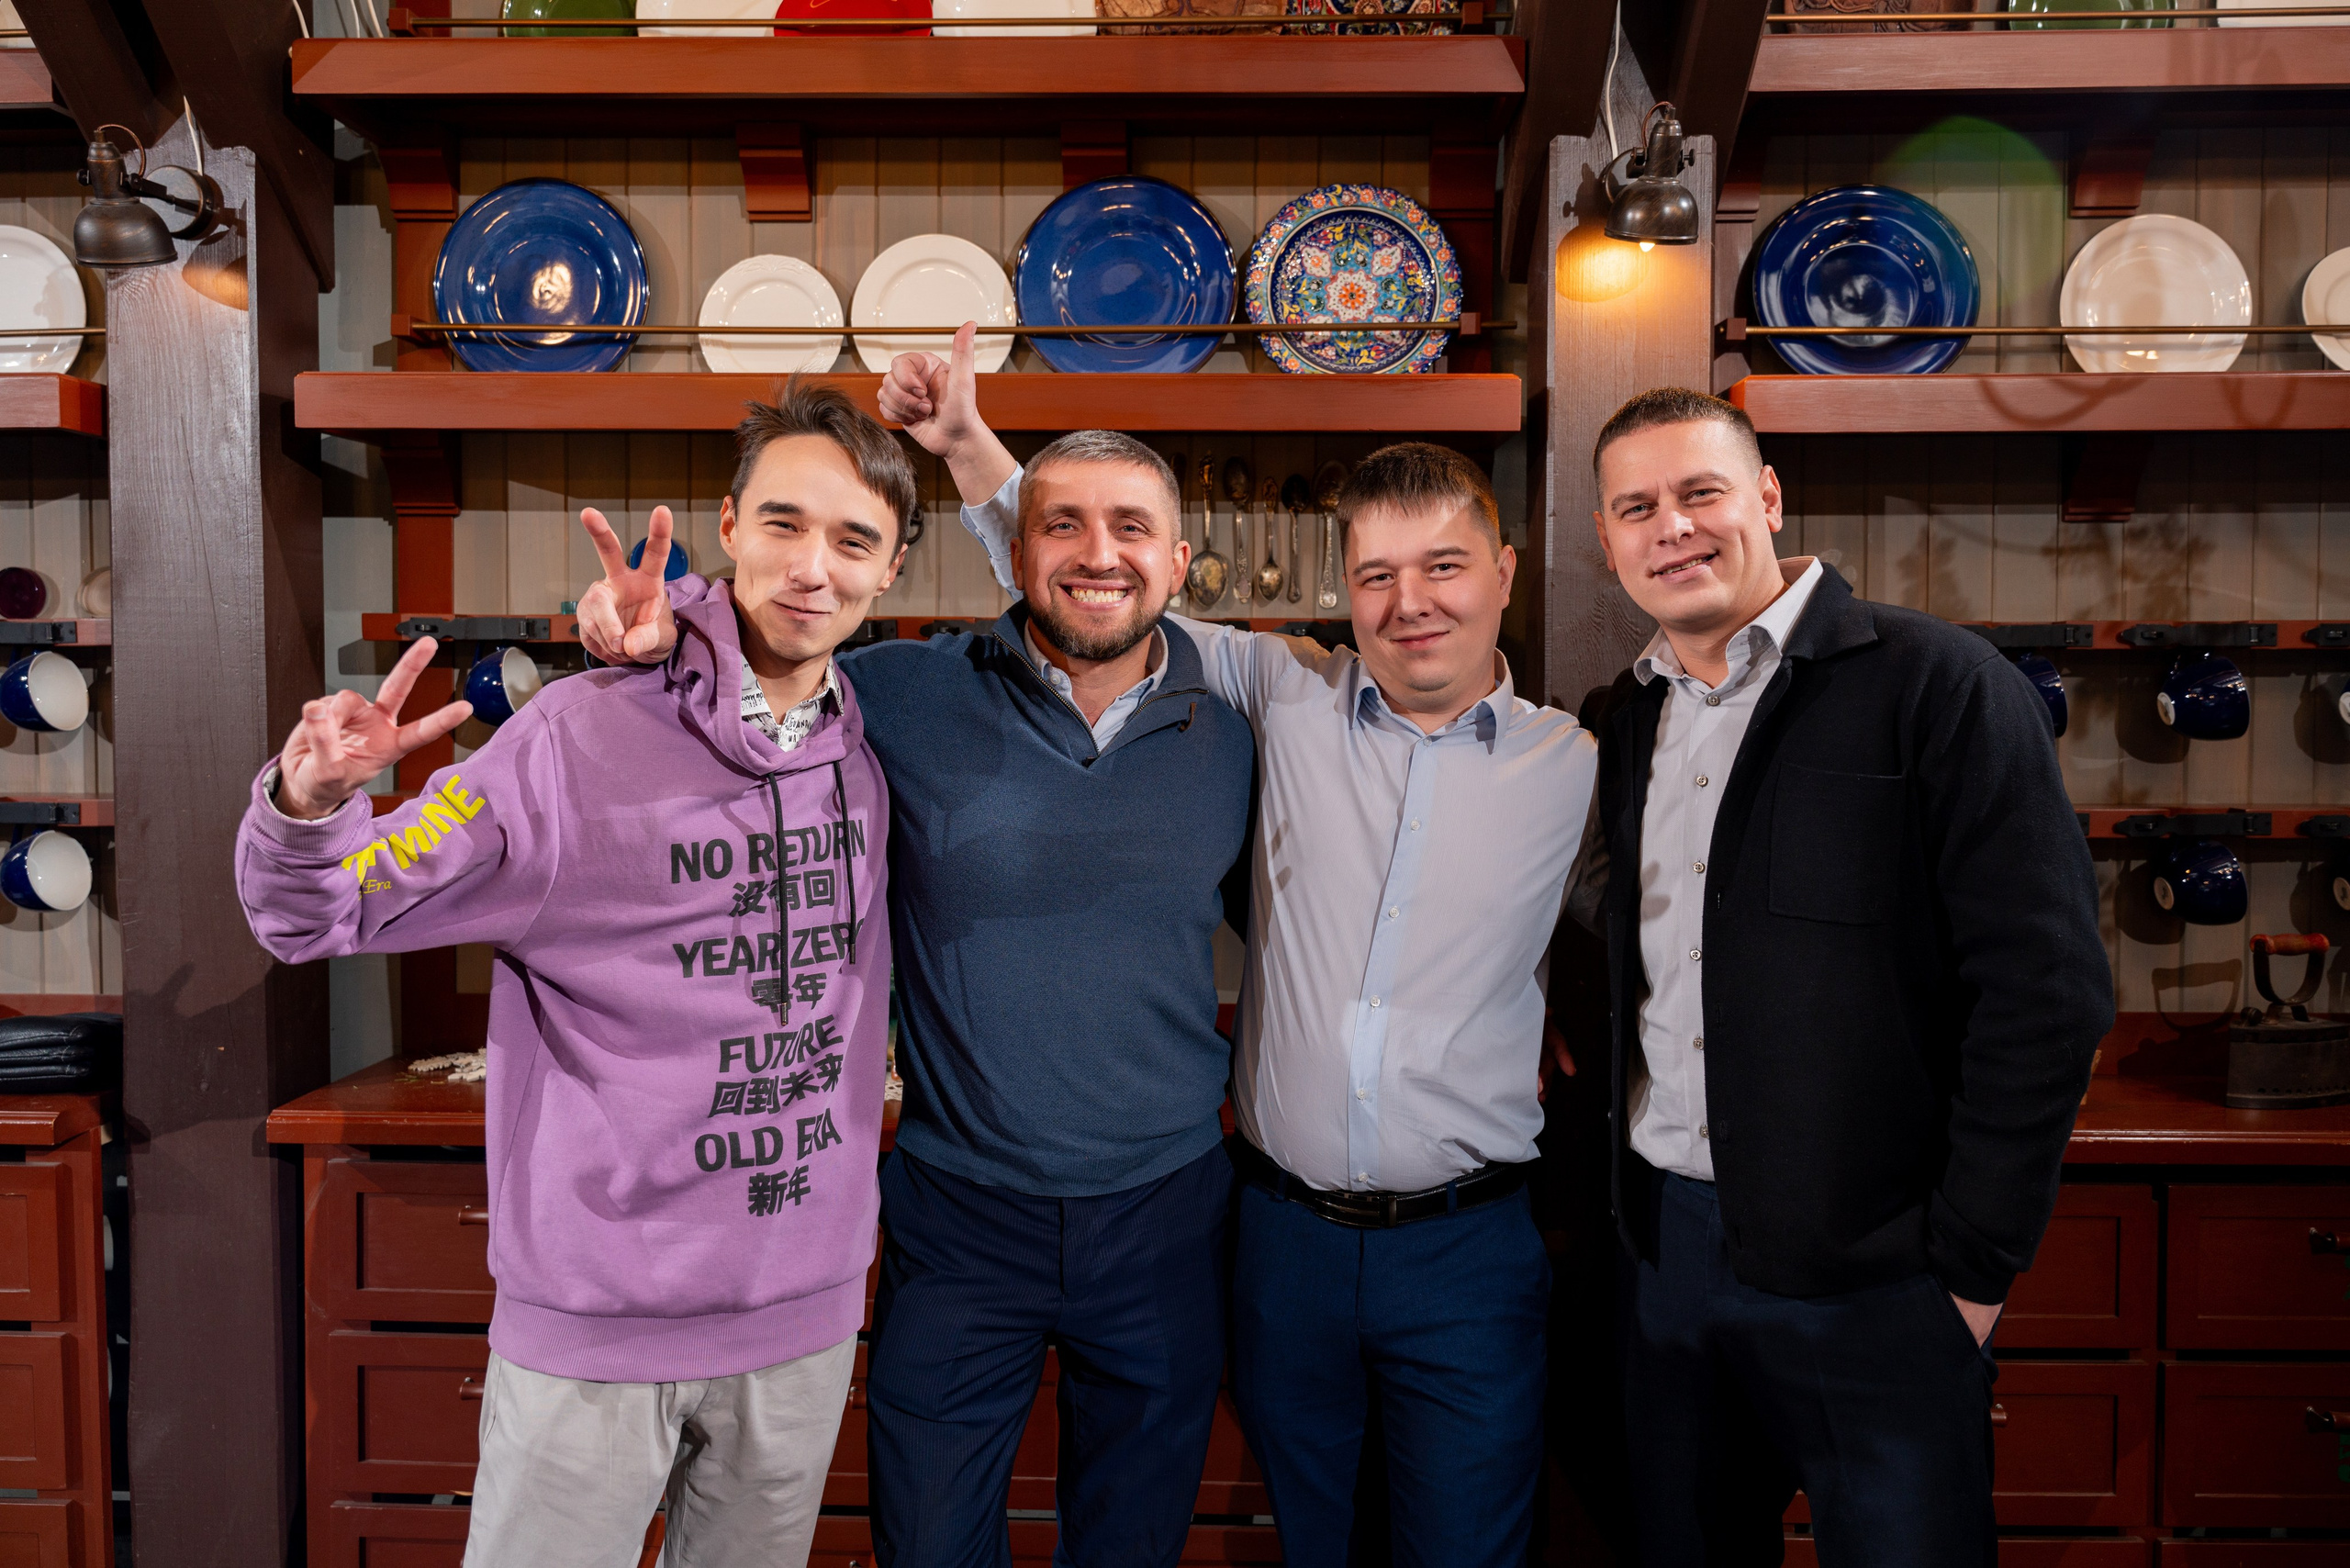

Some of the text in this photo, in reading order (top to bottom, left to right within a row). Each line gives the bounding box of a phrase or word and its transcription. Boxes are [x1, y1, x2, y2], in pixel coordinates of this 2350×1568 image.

[671, 819, 867, 884] NO RETURN
[729, 868, 835, 917] 没有回
[672, 918, 865, 979] YEAR ZER
[719, 1014, 845, 1073] FUTURE
[708, 1053, 844, 1118] 回到未来
[694, 1107, 843, 1172] OLD ERA
[748, 1164, 811, 1217] 新年
